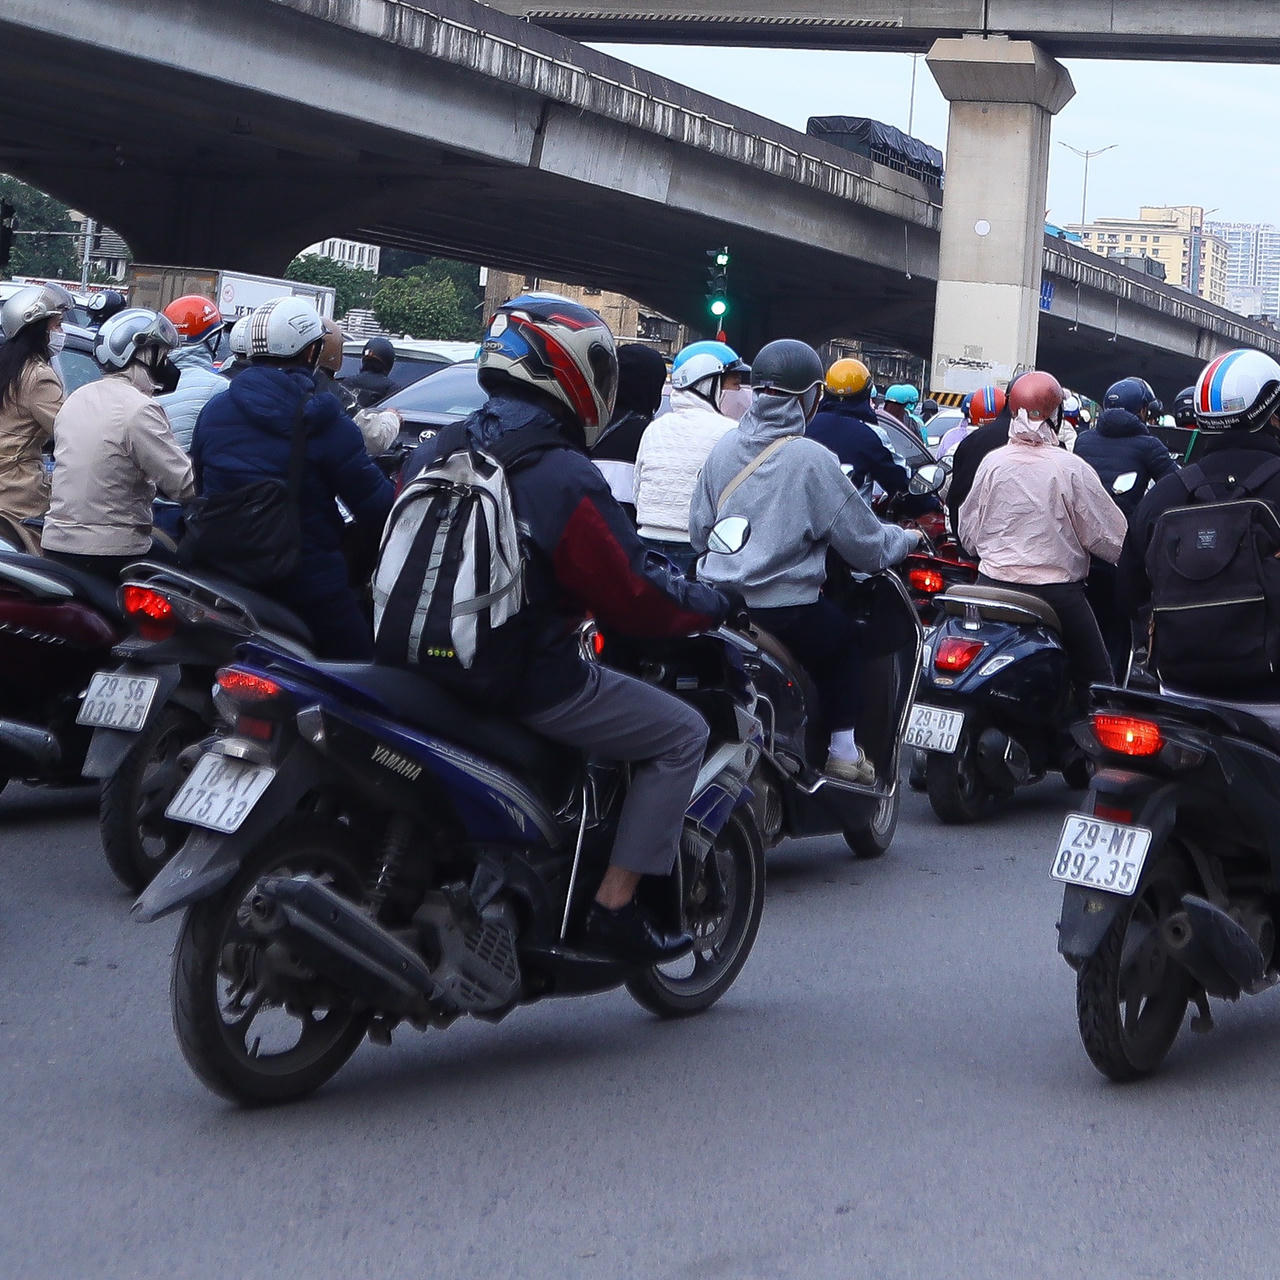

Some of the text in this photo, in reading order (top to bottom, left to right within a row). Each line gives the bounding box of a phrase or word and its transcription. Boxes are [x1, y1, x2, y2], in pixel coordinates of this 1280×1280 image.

[915, 709, 955, 732] 29-B1
[906, 728, 955, 751] 662.10
[371, 745, 422, 782] YAMAHA
[176, 787, 248, 826] 175.13
[1071, 821, 1137, 858] 29-M1
[1056, 849, 1136, 890] 892.35
